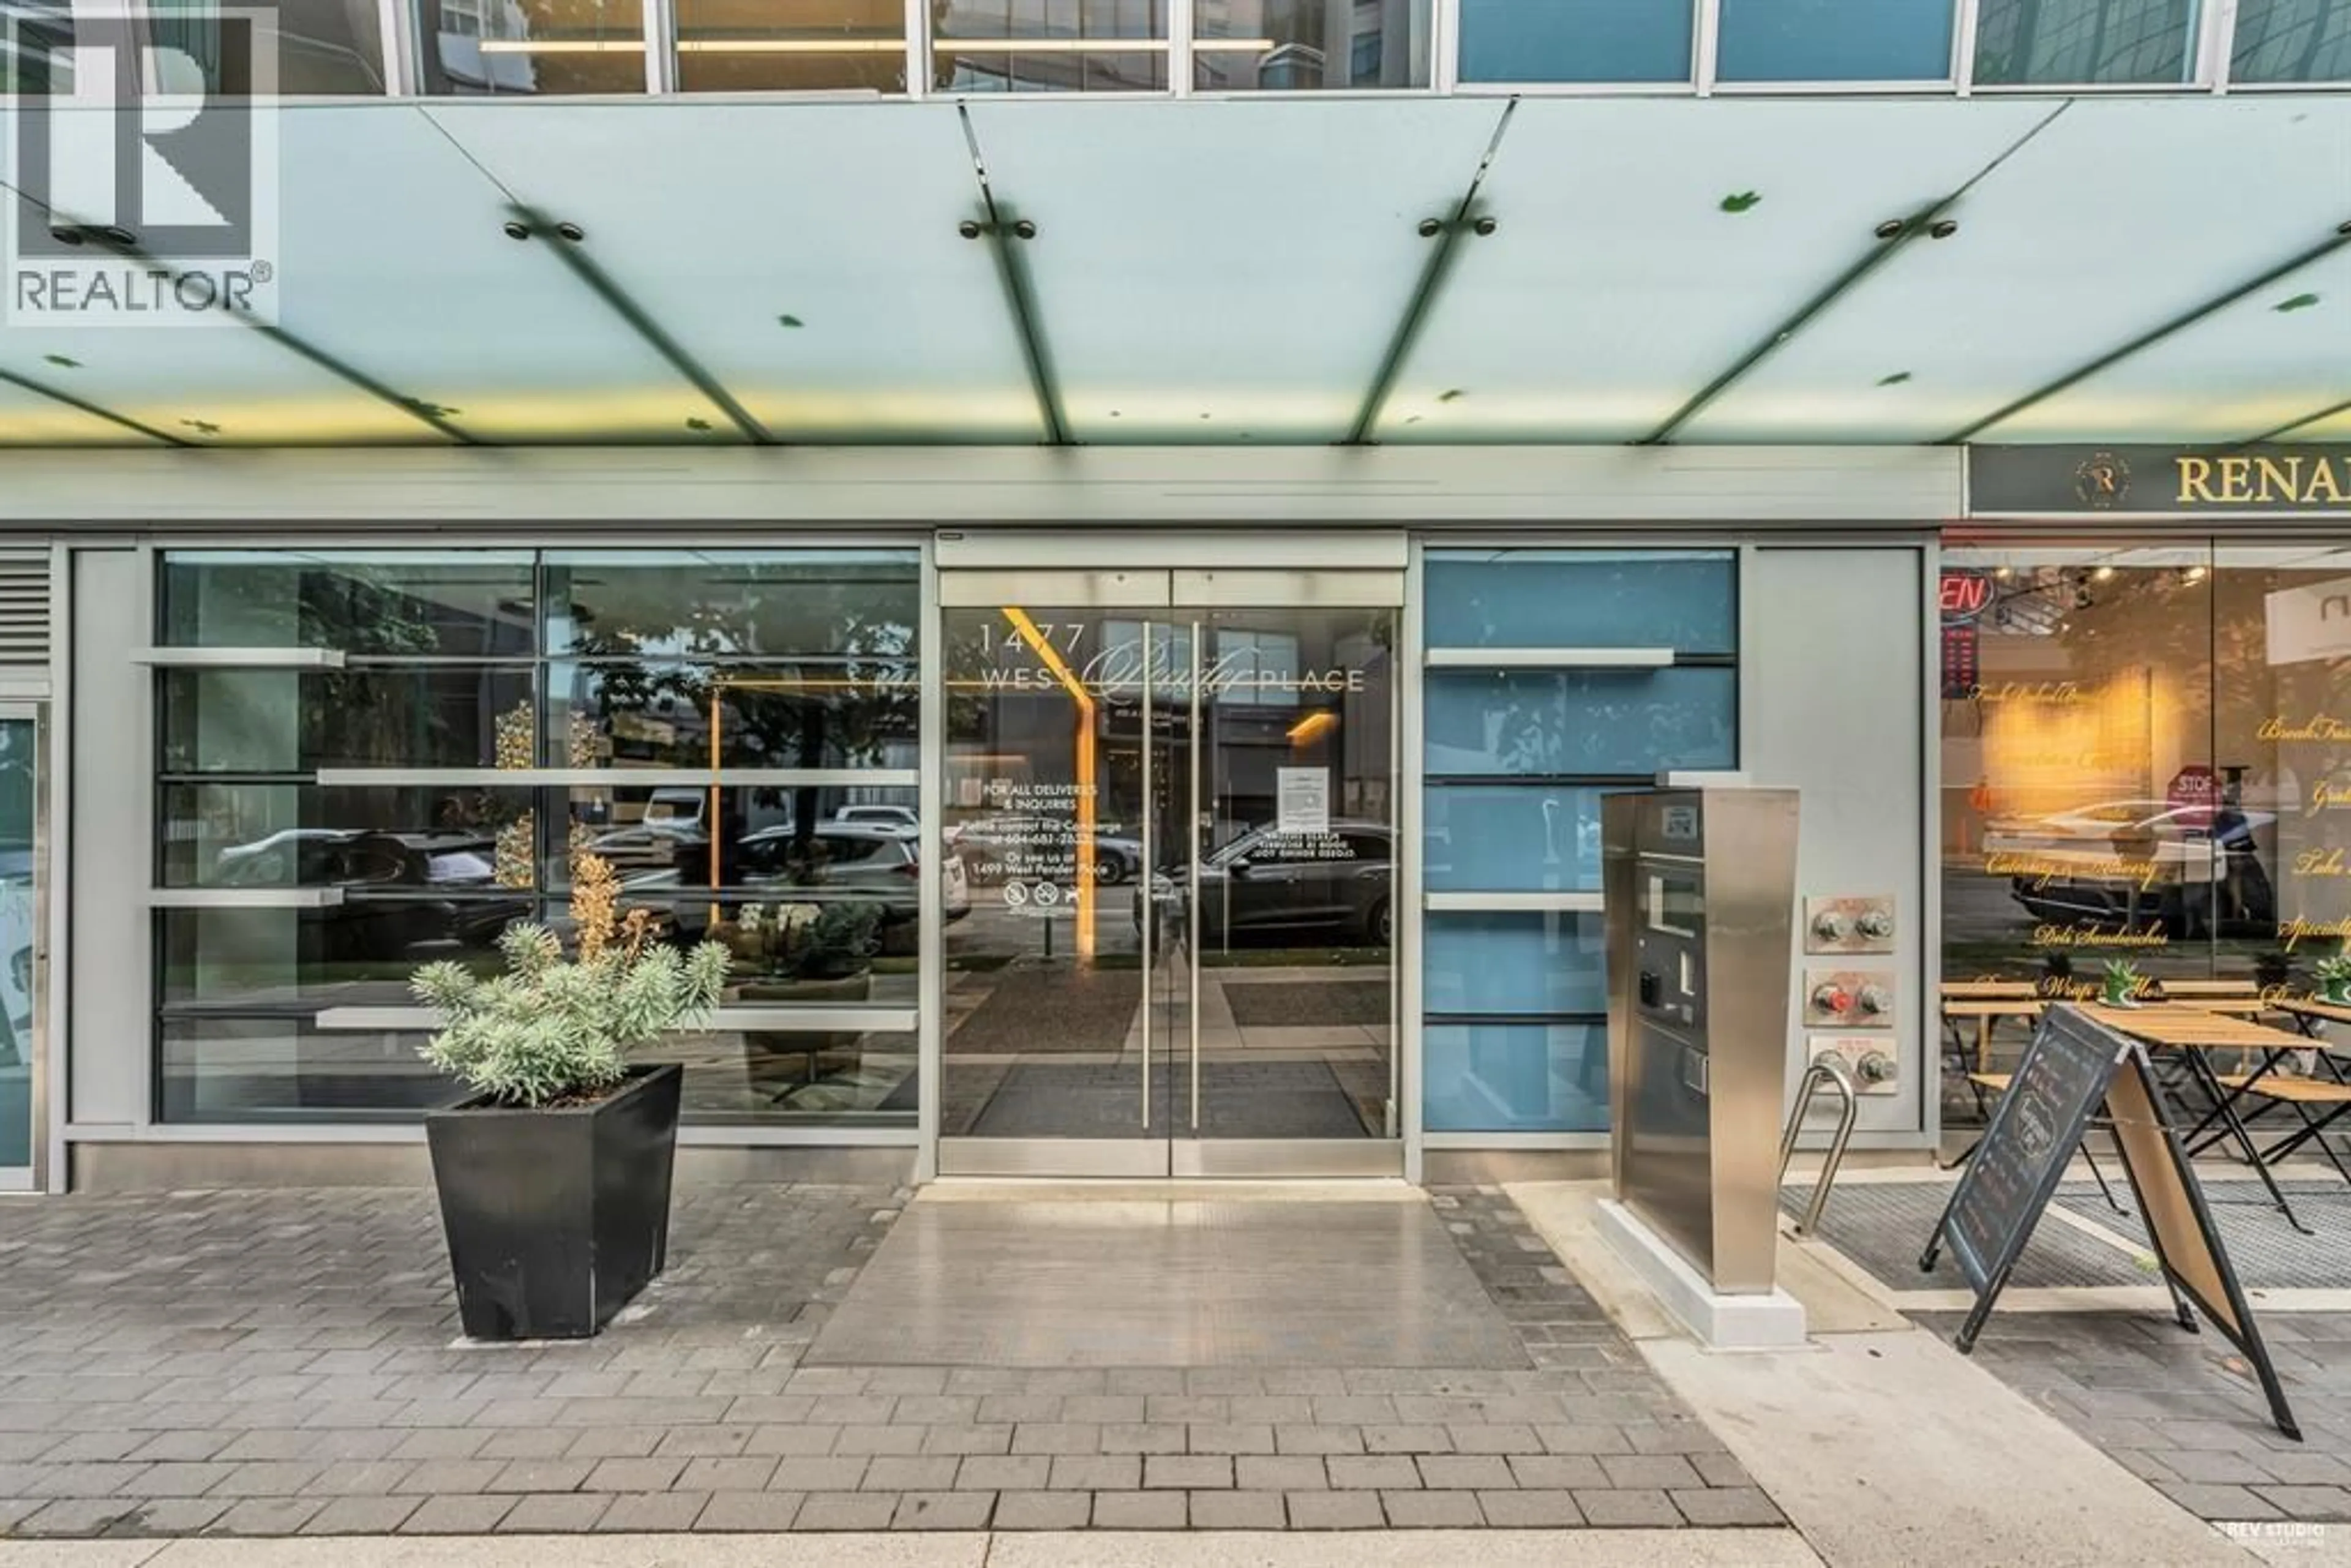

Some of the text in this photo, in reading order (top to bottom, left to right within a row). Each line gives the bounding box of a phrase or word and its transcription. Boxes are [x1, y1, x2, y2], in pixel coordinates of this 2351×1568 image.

[2176, 457, 2351, 502] RENA
[980, 624, 1085, 653] 1477
[1259, 669, 1365, 692] PLACE
[1010, 785, 1032, 795] ALL
